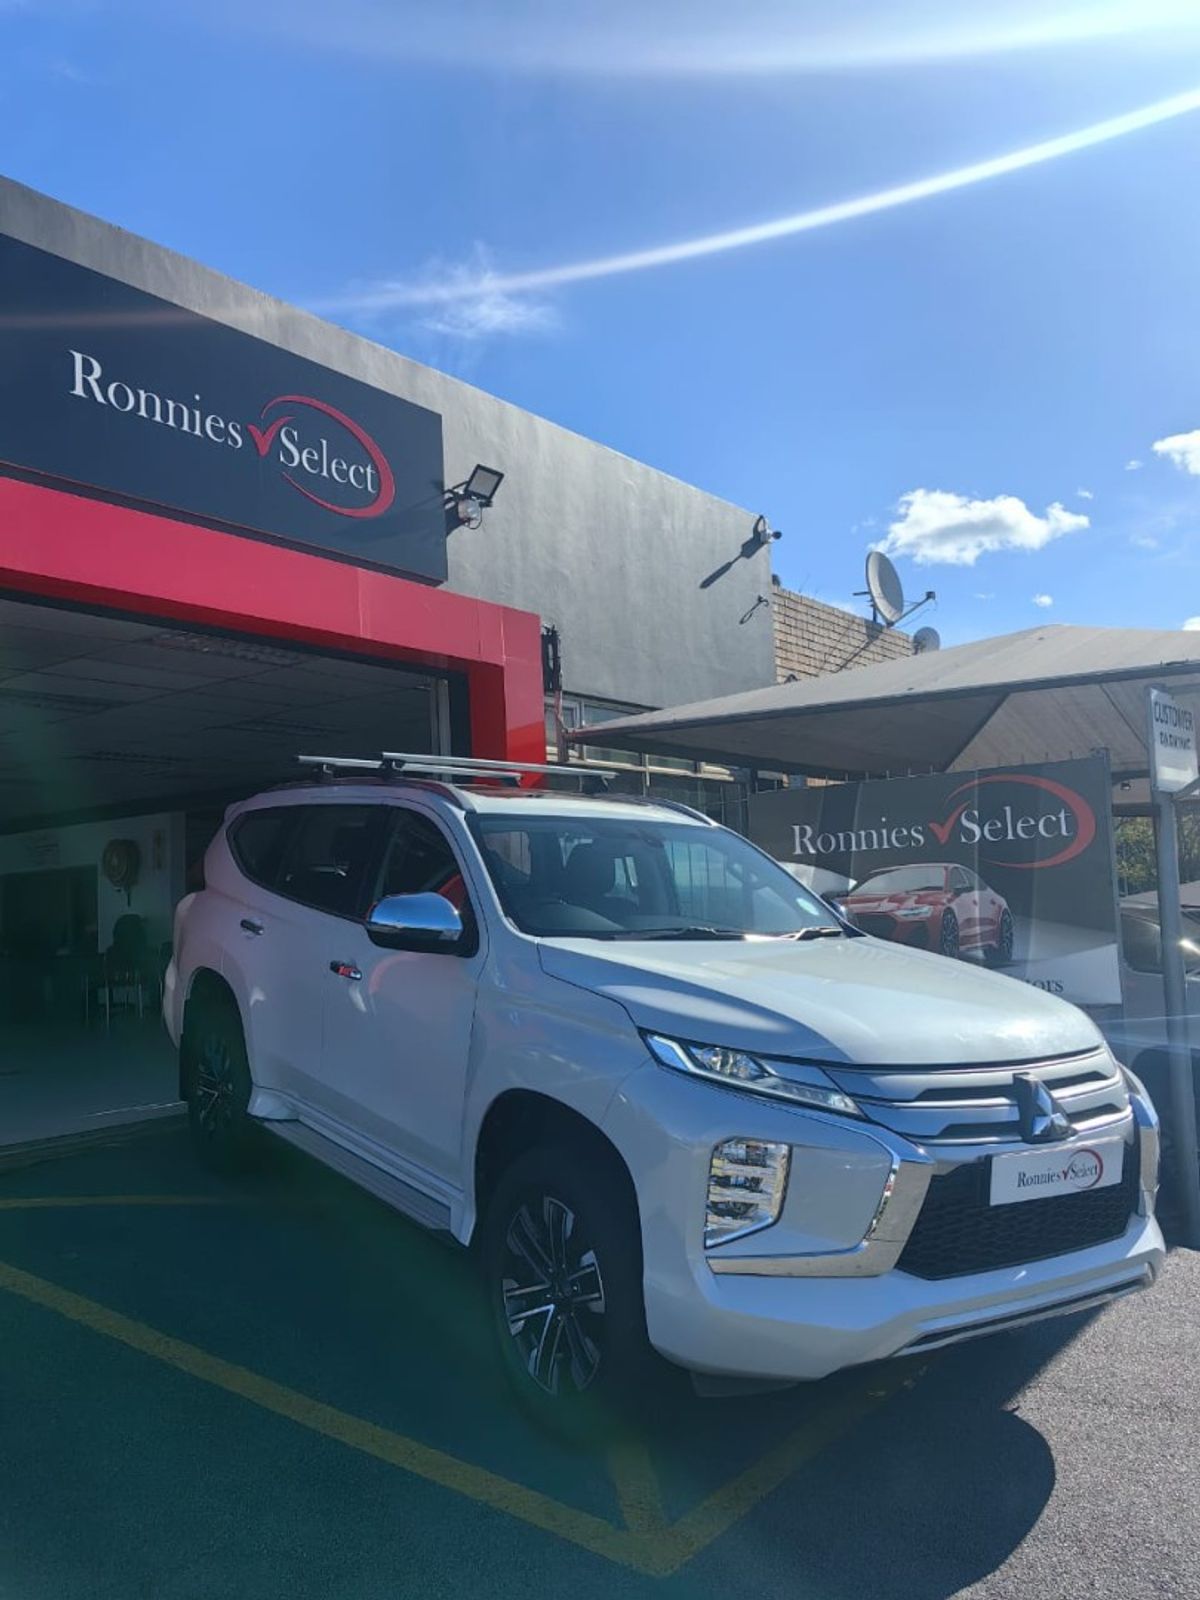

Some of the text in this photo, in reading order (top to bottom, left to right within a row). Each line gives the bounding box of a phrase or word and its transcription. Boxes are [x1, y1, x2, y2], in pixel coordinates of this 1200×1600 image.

[69, 350, 377, 494] Ronnies Select
[792, 806, 1073, 854] Ronnies Select
[1017, 1163, 1098, 1188] Ronnies Select
